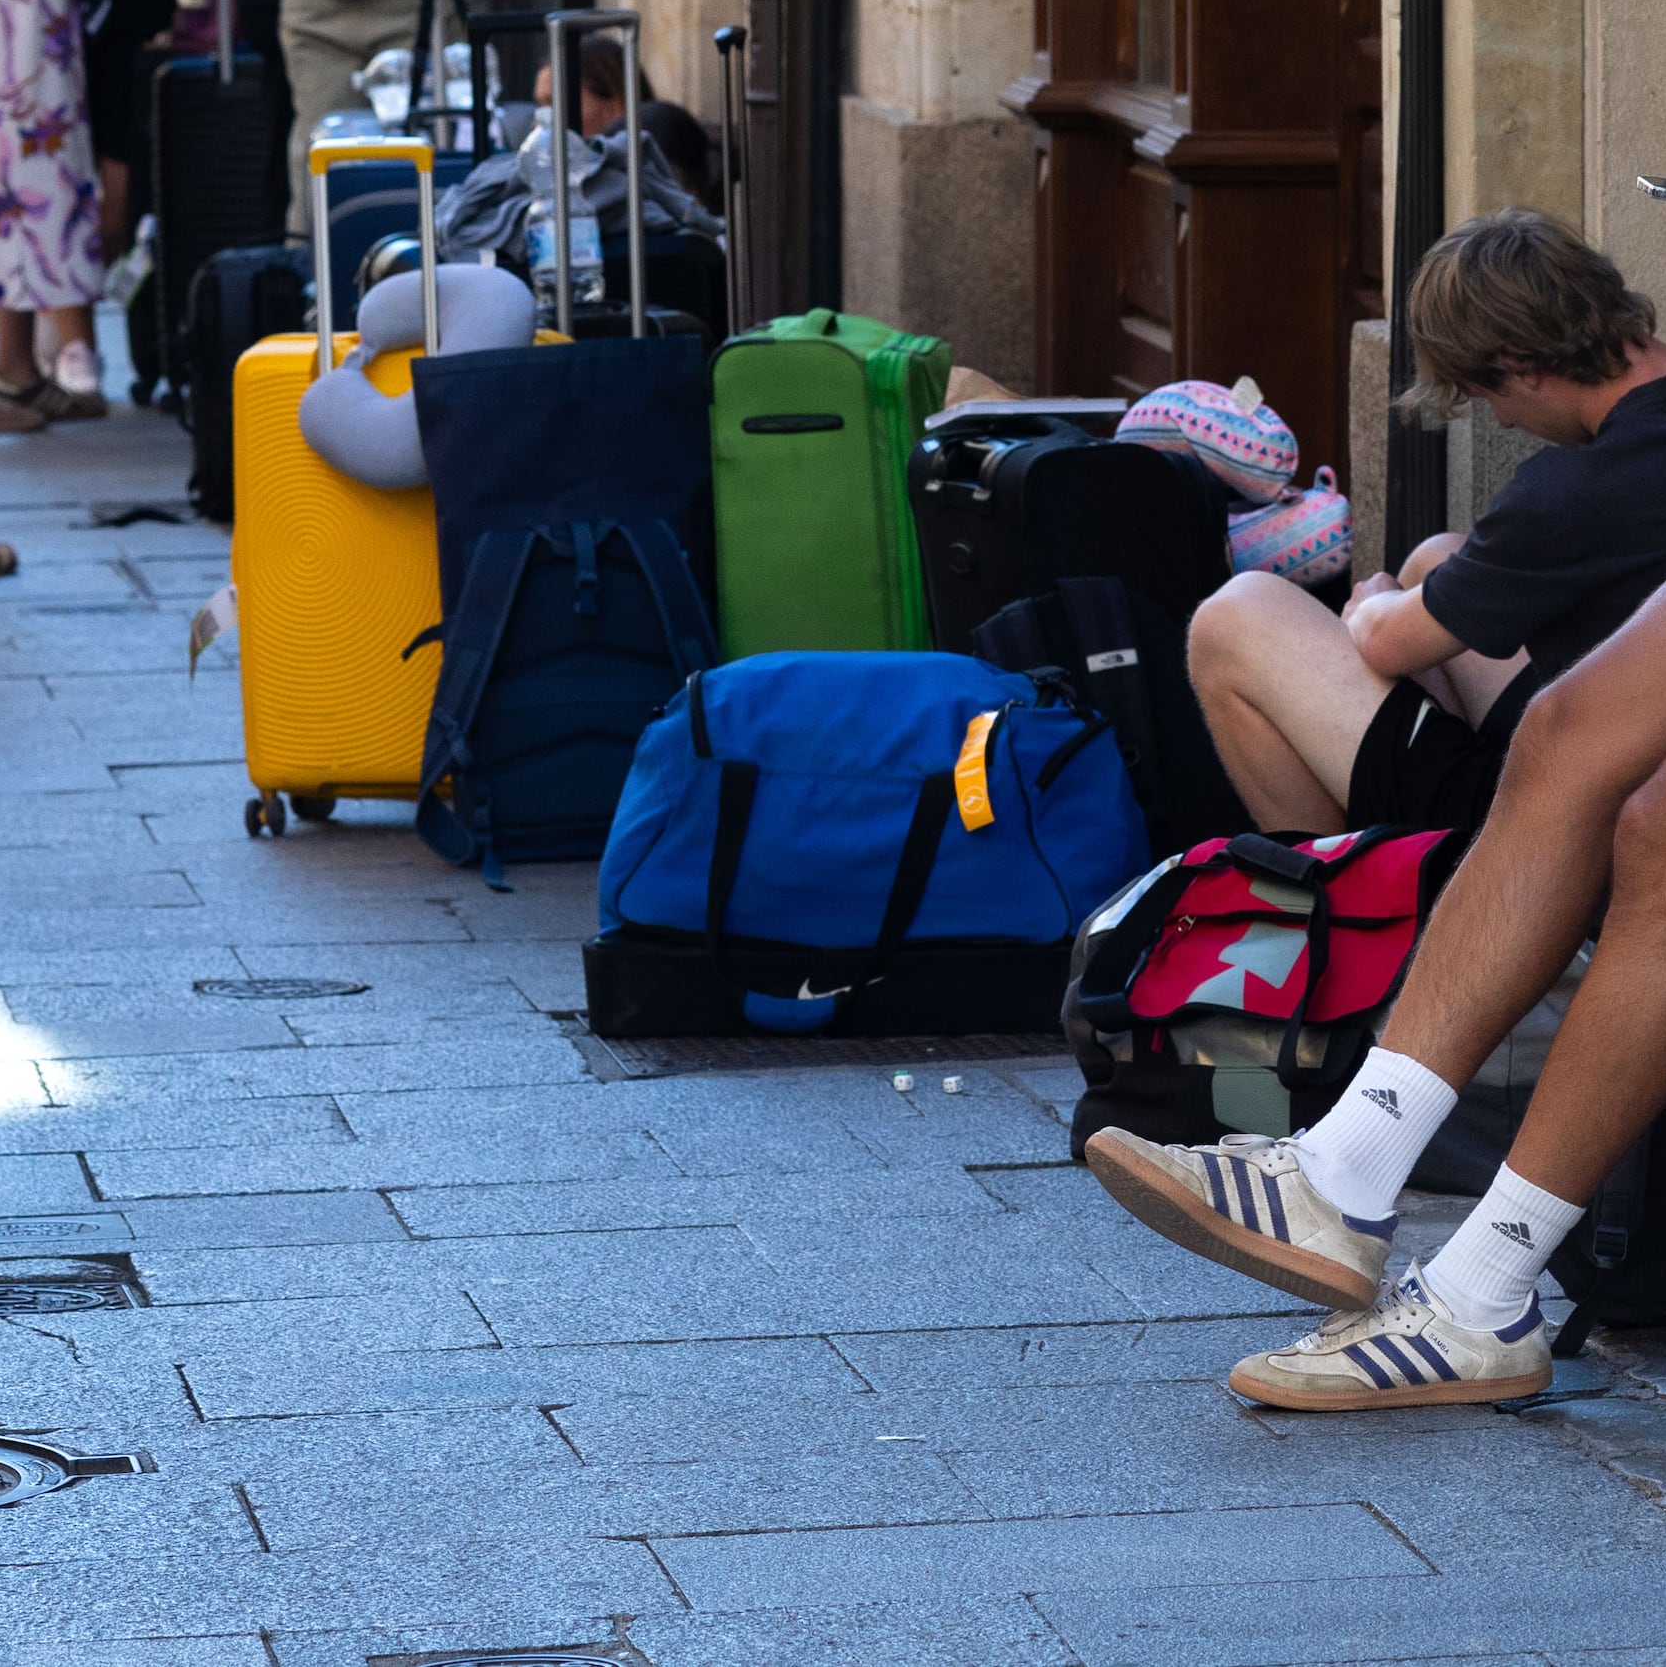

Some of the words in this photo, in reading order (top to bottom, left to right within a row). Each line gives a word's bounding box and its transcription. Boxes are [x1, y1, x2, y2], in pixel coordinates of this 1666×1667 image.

[1361, 1088, 1404, 1121] adidas
[1491, 1221, 1536, 1251] adidas
[1428, 1333, 1450, 1355] SAMBA
